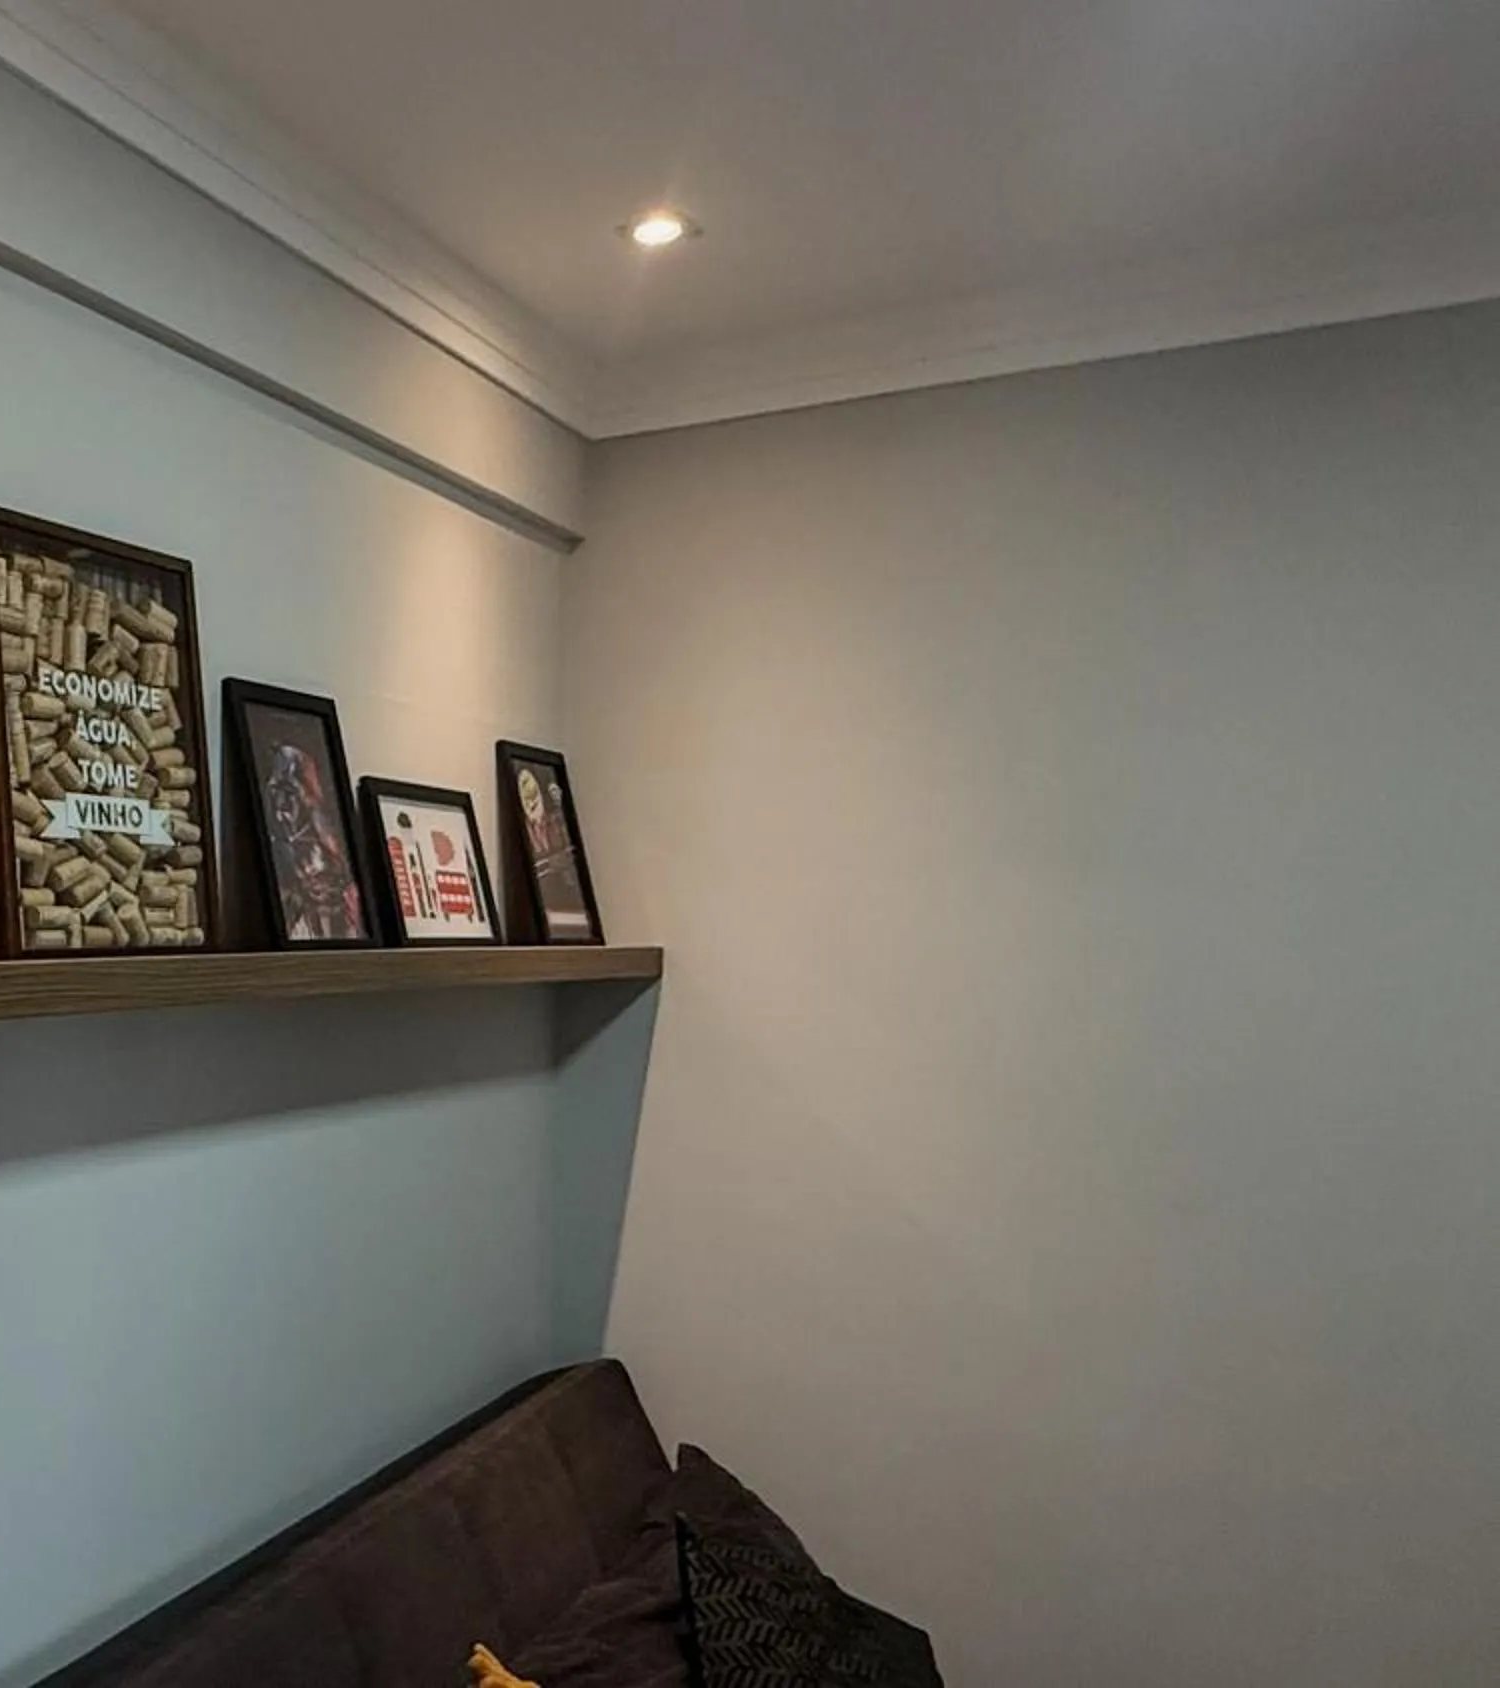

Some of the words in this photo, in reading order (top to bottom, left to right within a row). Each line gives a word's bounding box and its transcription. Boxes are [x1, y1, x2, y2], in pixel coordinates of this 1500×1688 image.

[39, 669, 162, 710] ECONOMIZE
[77, 759, 138, 789] TOME
[75, 799, 143, 827] VINHO
